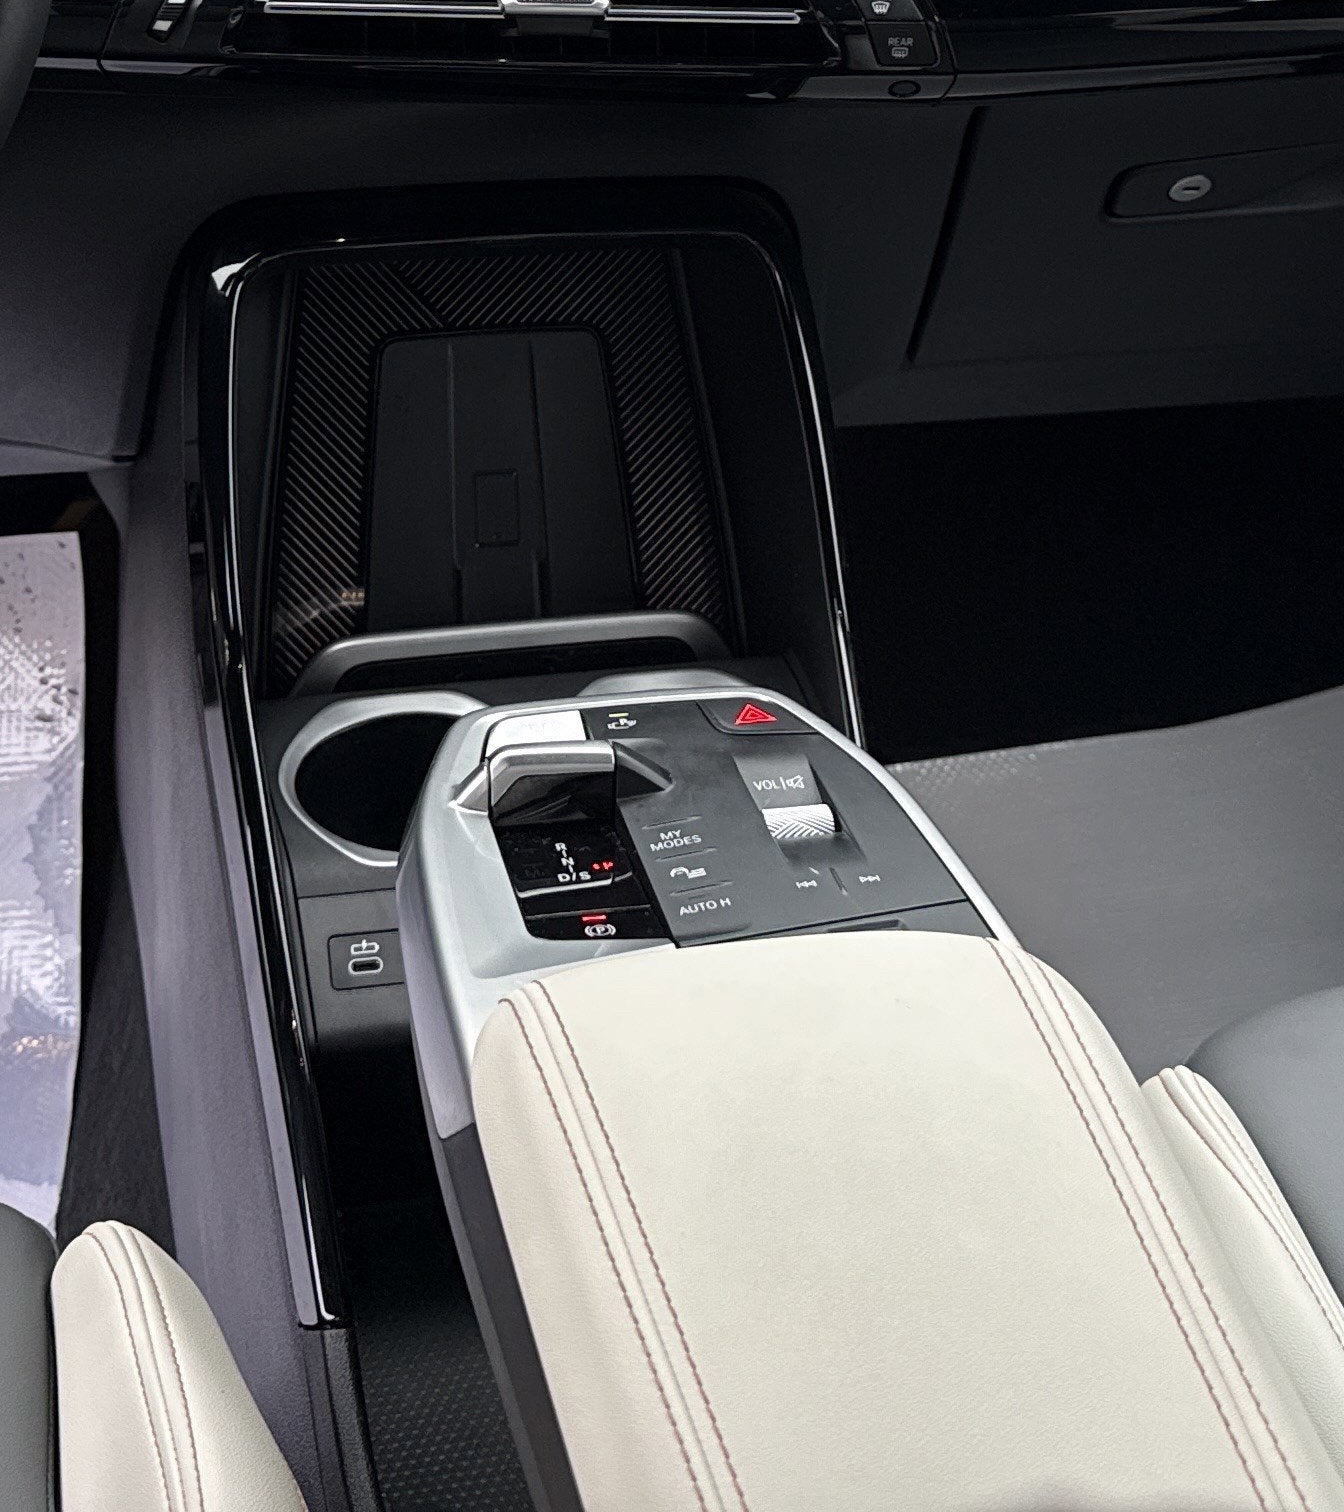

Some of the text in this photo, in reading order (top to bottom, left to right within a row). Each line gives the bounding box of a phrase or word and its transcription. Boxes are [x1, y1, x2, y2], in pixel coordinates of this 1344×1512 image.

[888, 37, 913, 47] REAR
[660, 829, 682, 841] MY
[555, 842, 567, 851] R
[650, 835, 702, 851] MODES
[561, 857, 574, 866] N
[680, 898, 731, 916] AUTO H
